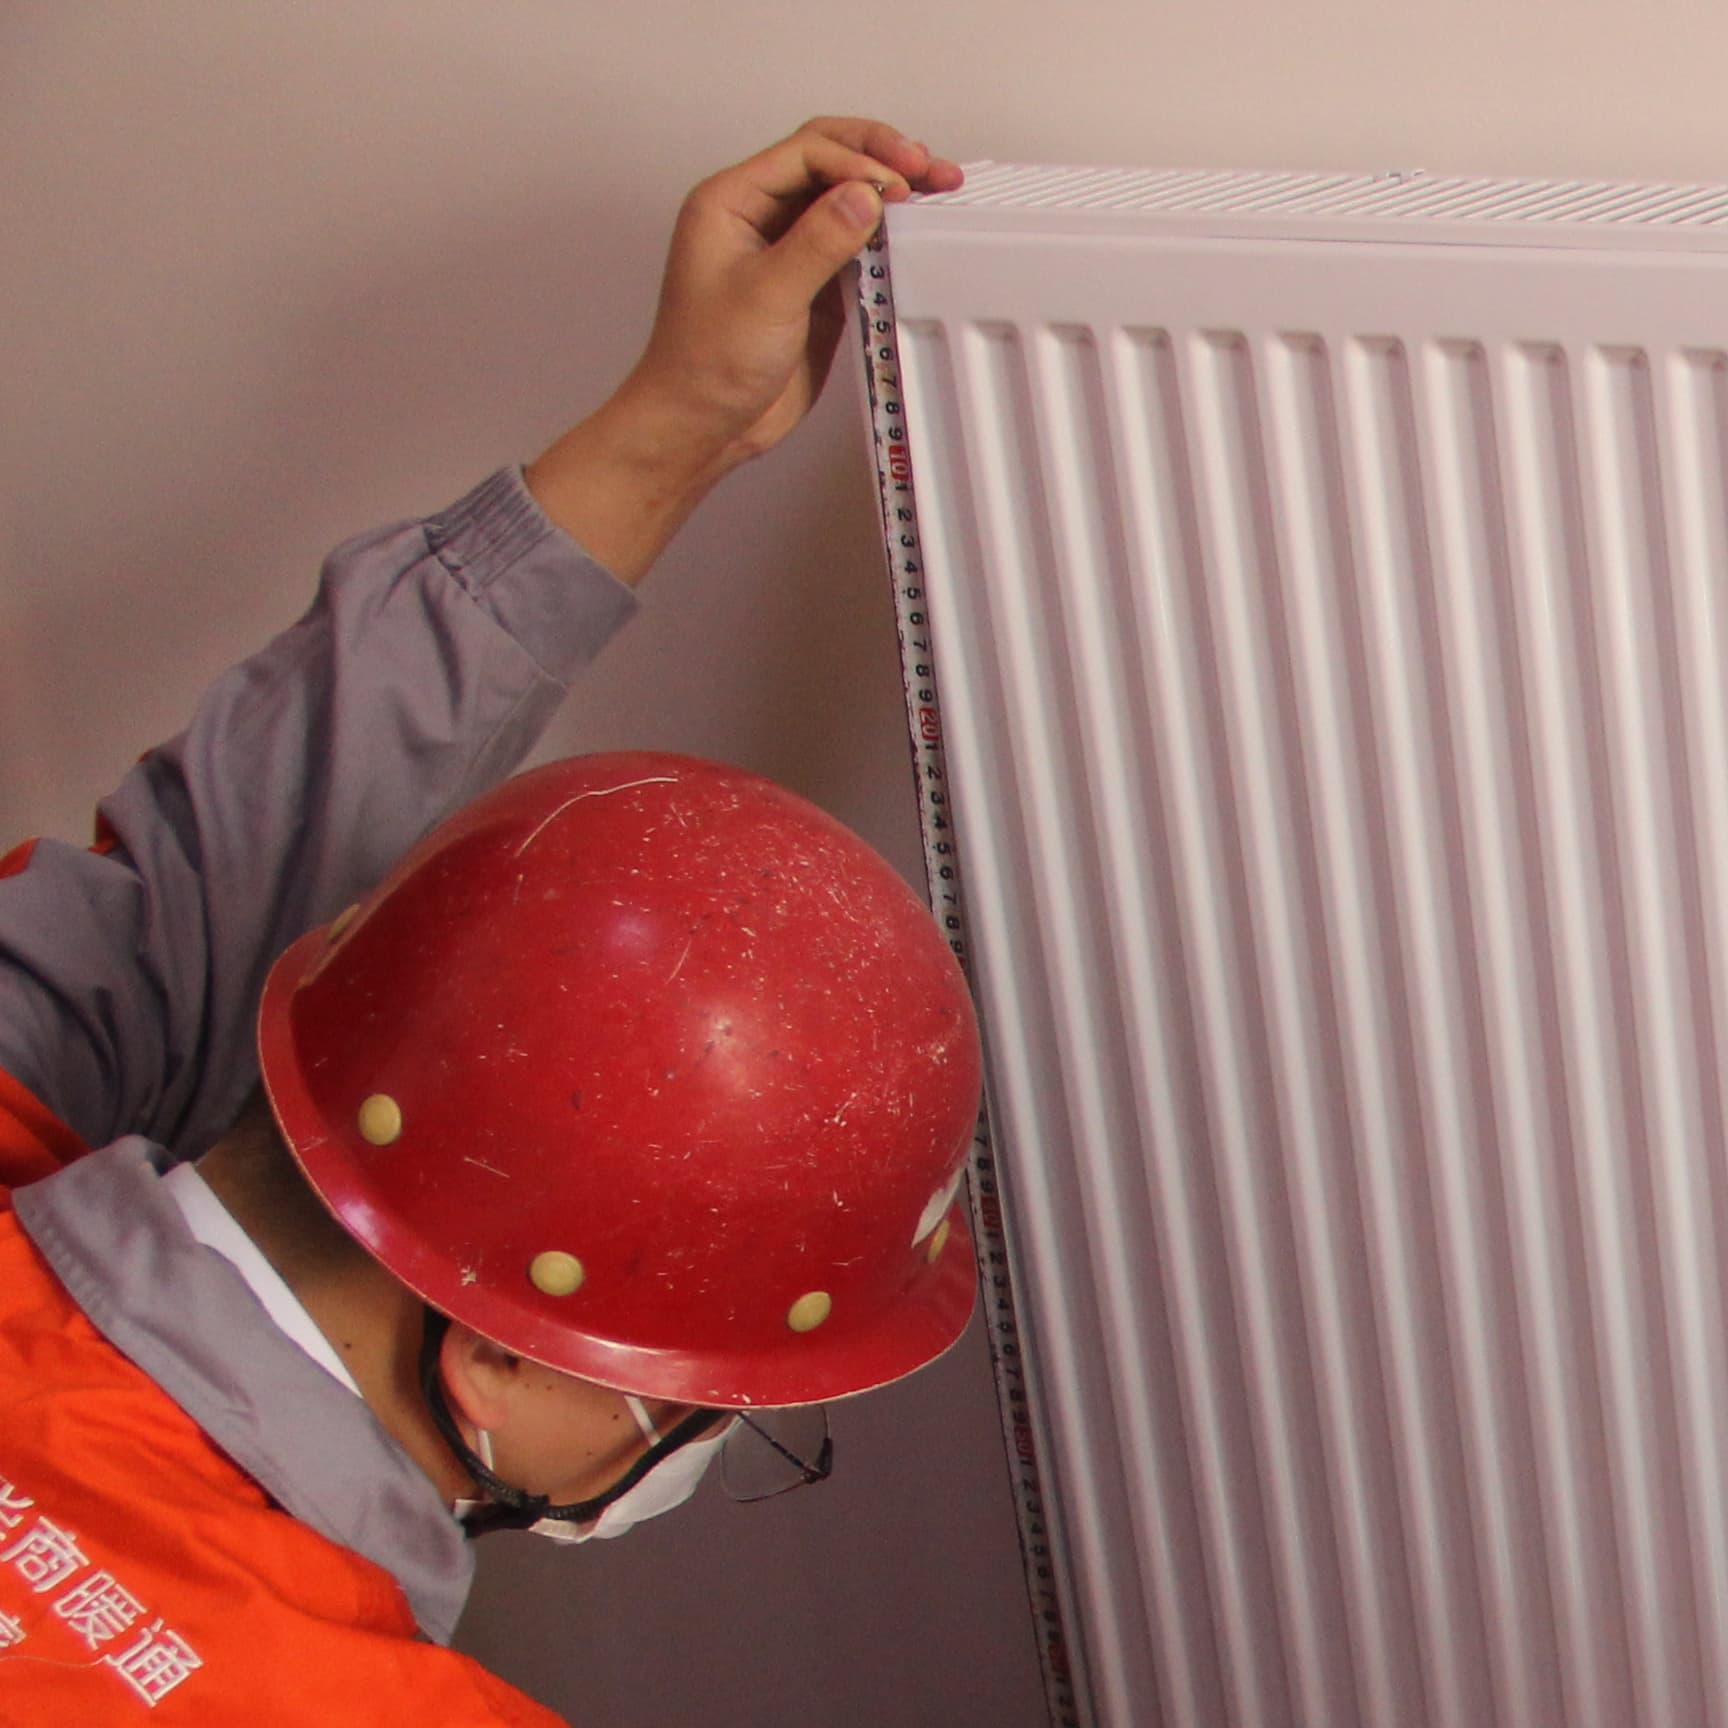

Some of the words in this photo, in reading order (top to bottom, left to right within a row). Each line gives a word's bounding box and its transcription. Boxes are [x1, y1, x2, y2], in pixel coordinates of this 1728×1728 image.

[870, 264, 885, 279] 3
[873, 292, 888, 306] 4
[876, 320, 891, 334] 5
[880, 347, 894, 361] 6
[882, 375, 897, 389] 7
[885, 401, 900, 415] 8
[888, 426, 903, 441] 9
[897, 507, 912, 522] 2
[900, 534, 915, 548] 3
[904, 560, 918, 574] 4
[907, 587, 921, 600] 5
[909, 612, 924, 626] 6
[913, 637, 927, 652] 7
[915, 664, 930, 677] 8
[918, 689, 933, 702] 9
[920, 709, 938, 736] 20
[927, 765, 942, 780] 2
[940, 865, 954, 880] 6
[943, 892, 957, 905] 7
